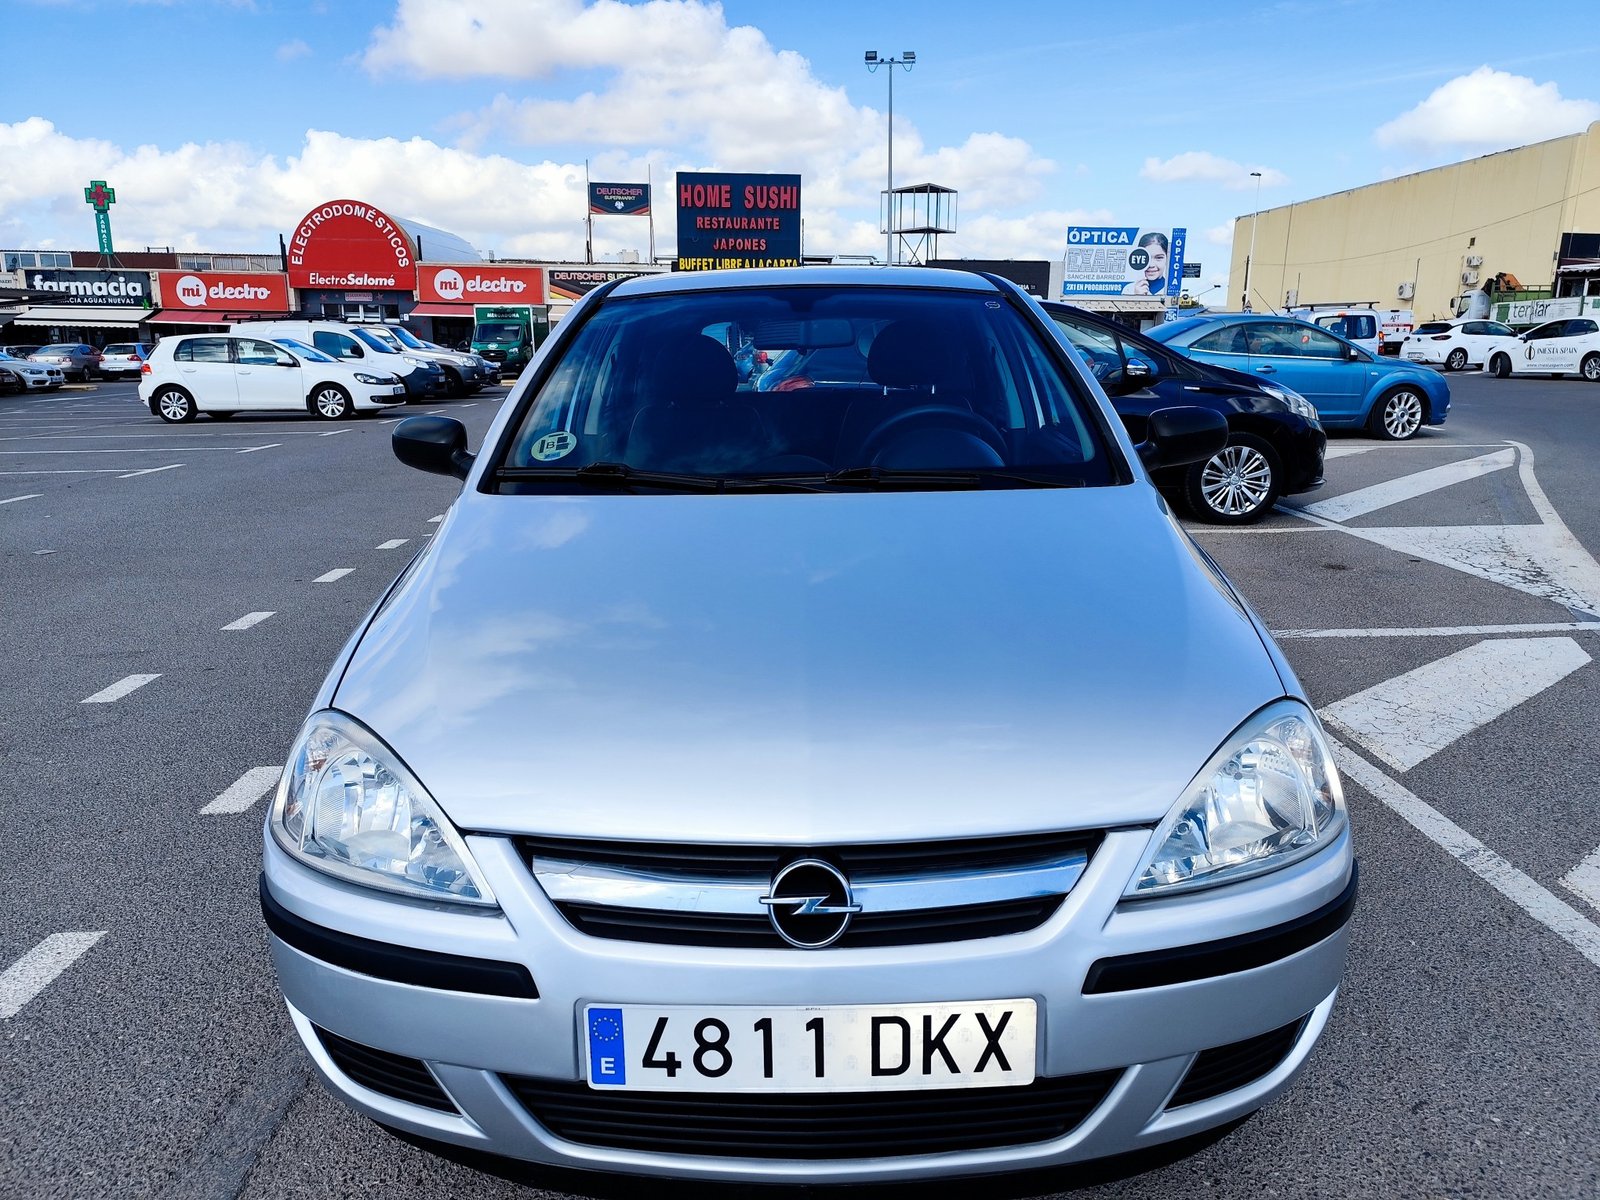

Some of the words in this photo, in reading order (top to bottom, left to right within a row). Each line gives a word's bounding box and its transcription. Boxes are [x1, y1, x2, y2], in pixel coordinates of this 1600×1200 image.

[596, 187, 643, 196] DEUTSCHER
[680, 184, 732, 208] HOME
[744, 185, 797, 210] SUSHI
[696, 217, 780, 230] RESTAURANTE
[100, 214, 110, 253] FARMACIA
[291, 204, 410, 268] ELECTRODOMÉSTICOS
[1068, 228, 1130, 244] ÓPTICA
[713, 238, 767, 251] JAPONES
[679, 257, 714, 271] BUFFET
[716, 258, 743, 269] LIBRE
[1131, 255, 1147, 264] EYE
[309, 272, 395, 287] ElectroSalomé
[554, 272, 607, 281] DEUTSCHER
[33, 274, 143, 297] farmacia
[182, 283, 202, 297] mi
[208, 283, 271, 300] electro
[440, 277, 459, 291] mi
[465, 276, 527, 293] electro
[1066, 283, 1077, 291] 2X1
[1084, 283, 1122, 292] PROGRESIVOS
[107, 297, 135, 305] NUEVAS
[641, 1016, 826, 1079] 4811
[870, 1010, 1014, 1077] DKX
[600, 1057, 616, 1075] E
